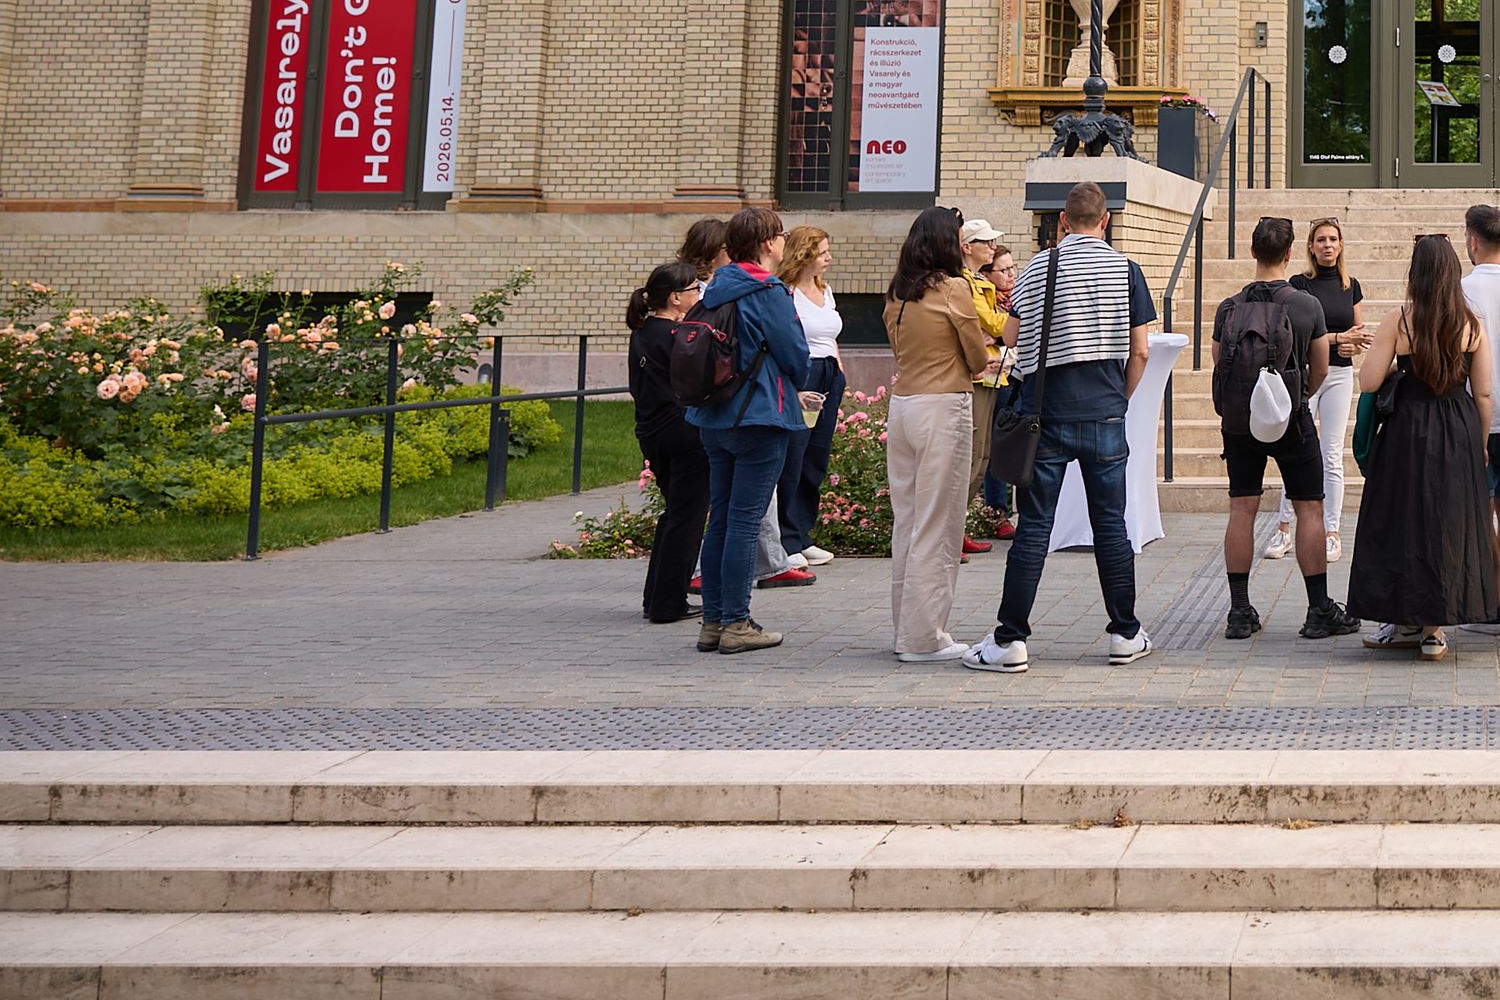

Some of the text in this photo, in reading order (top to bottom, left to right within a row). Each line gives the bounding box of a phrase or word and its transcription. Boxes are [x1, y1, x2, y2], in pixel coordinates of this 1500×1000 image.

[870, 38, 917, 47] Konstrukció,
[870, 48, 922, 56] rácsszerkezet
[869, 59, 902, 67] és illúzió
[869, 70, 901, 79] Vasarely
[334, 25, 367, 138] Don't
[868, 91, 920, 100] neoavantgárd
[867, 101, 923, 109] művészetében
[363, 56, 397, 183] Home!
[436, 92, 455, 182] 2026.05.14.
